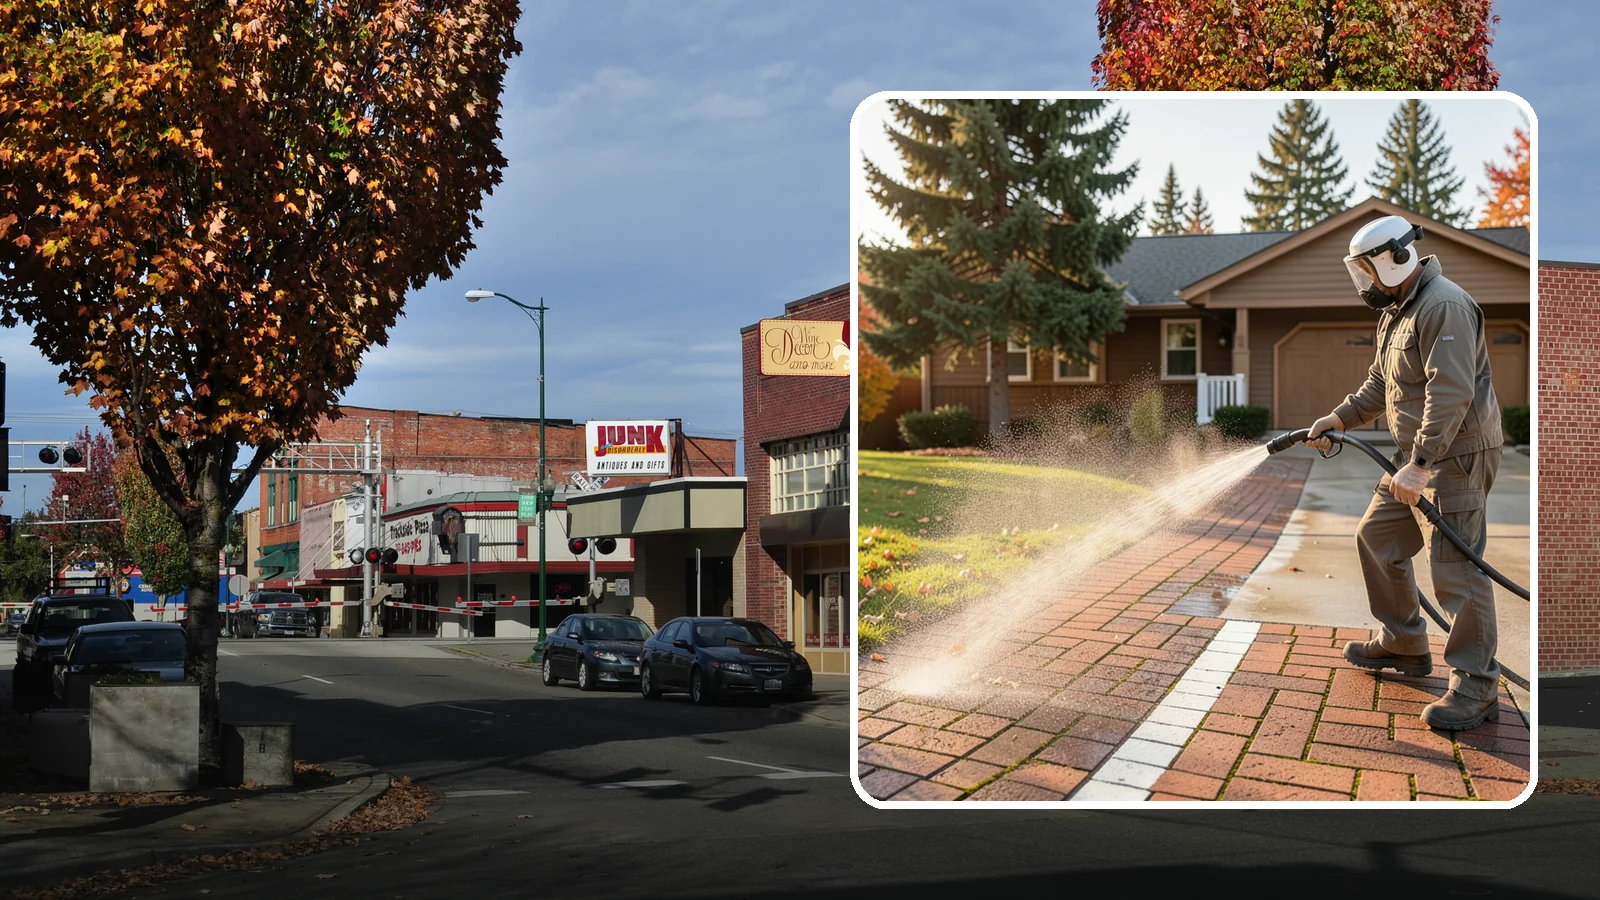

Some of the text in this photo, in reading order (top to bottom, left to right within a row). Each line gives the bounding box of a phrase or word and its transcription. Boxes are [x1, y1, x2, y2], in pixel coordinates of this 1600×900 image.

[596, 425, 665, 457] JUNK
[607, 446, 646, 454] DISORDERLY
[597, 461, 665, 470] ANTIQUES AND GIFTS
[414, 519, 429, 534] Pizza
